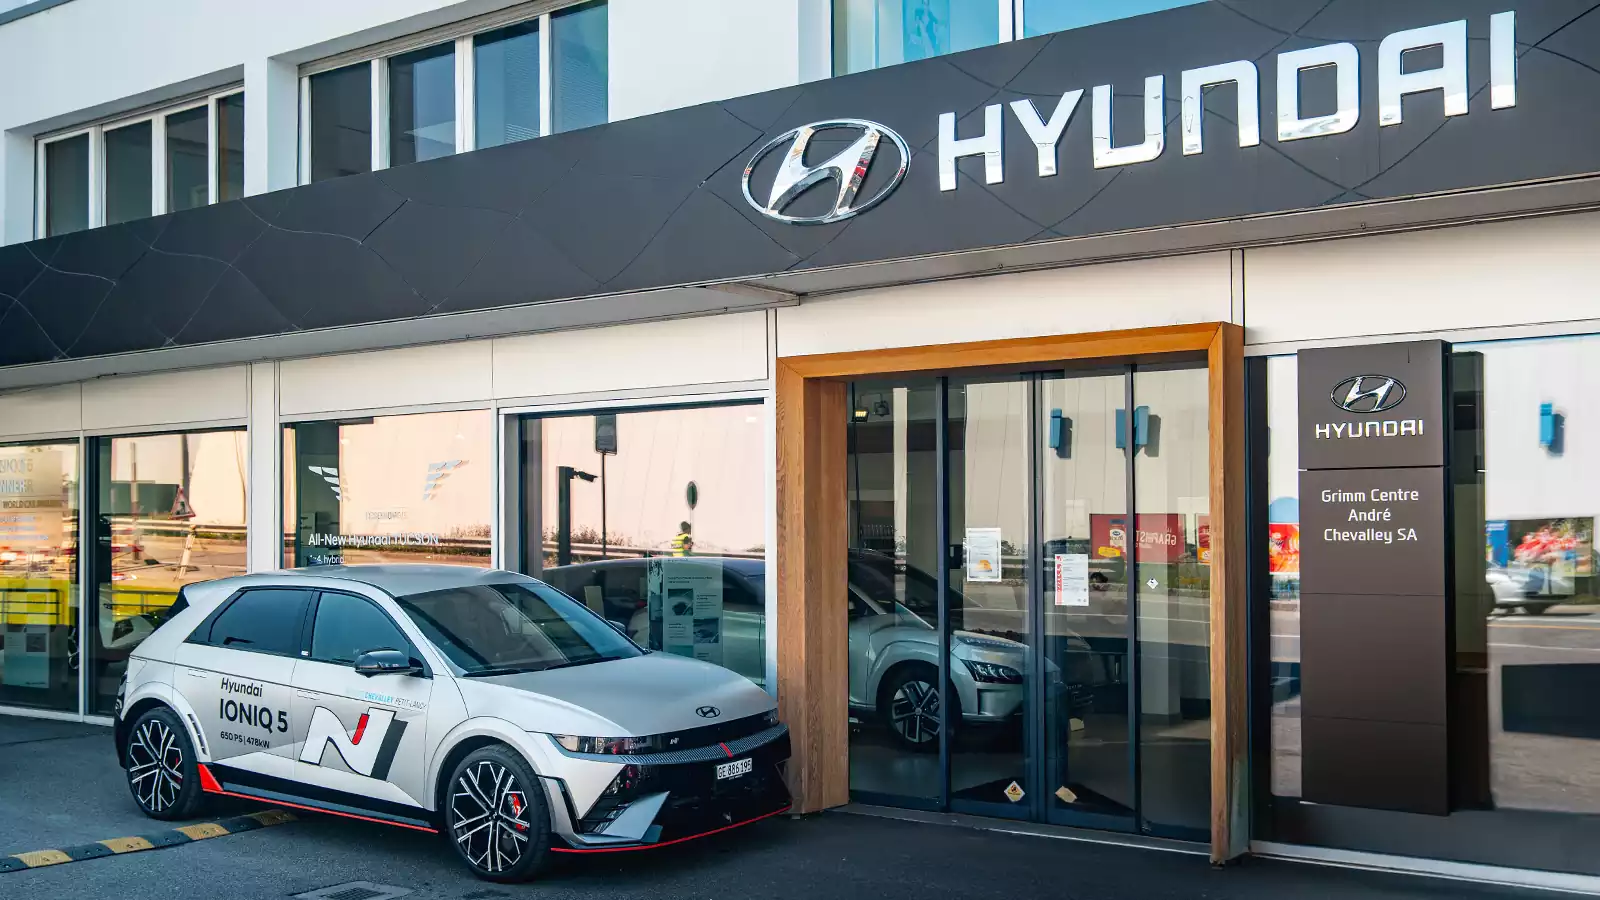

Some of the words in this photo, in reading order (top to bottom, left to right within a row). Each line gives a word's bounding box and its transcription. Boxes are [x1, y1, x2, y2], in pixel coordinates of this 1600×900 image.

[938, 10, 1516, 191] HYUNDAI
[1315, 419, 1424, 438] HYUNDAI
[1321, 489, 1366, 503] Grimm
[1370, 488, 1419, 502] Centre
[1348, 508, 1391, 522] André
[308, 533, 346, 546] All-New
[348, 534, 391, 548] Hyundai
[393, 532, 438, 545] TUCSON
[1324, 528, 1393, 544] Chevalley
[1397, 528, 1418, 541] SA
[323, 554, 344, 567] hybrid
[220, 677, 263, 698] Hyundai
[364, 691, 393, 704] CHEVALLEY
[219, 698, 274, 735] IONIQ
[277, 710, 289, 733] 5
[220, 730, 234, 741] 650
[718, 766, 727, 778] GE
[727, 763, 740, 776] 886
[740, 759, 752, 773] 195
